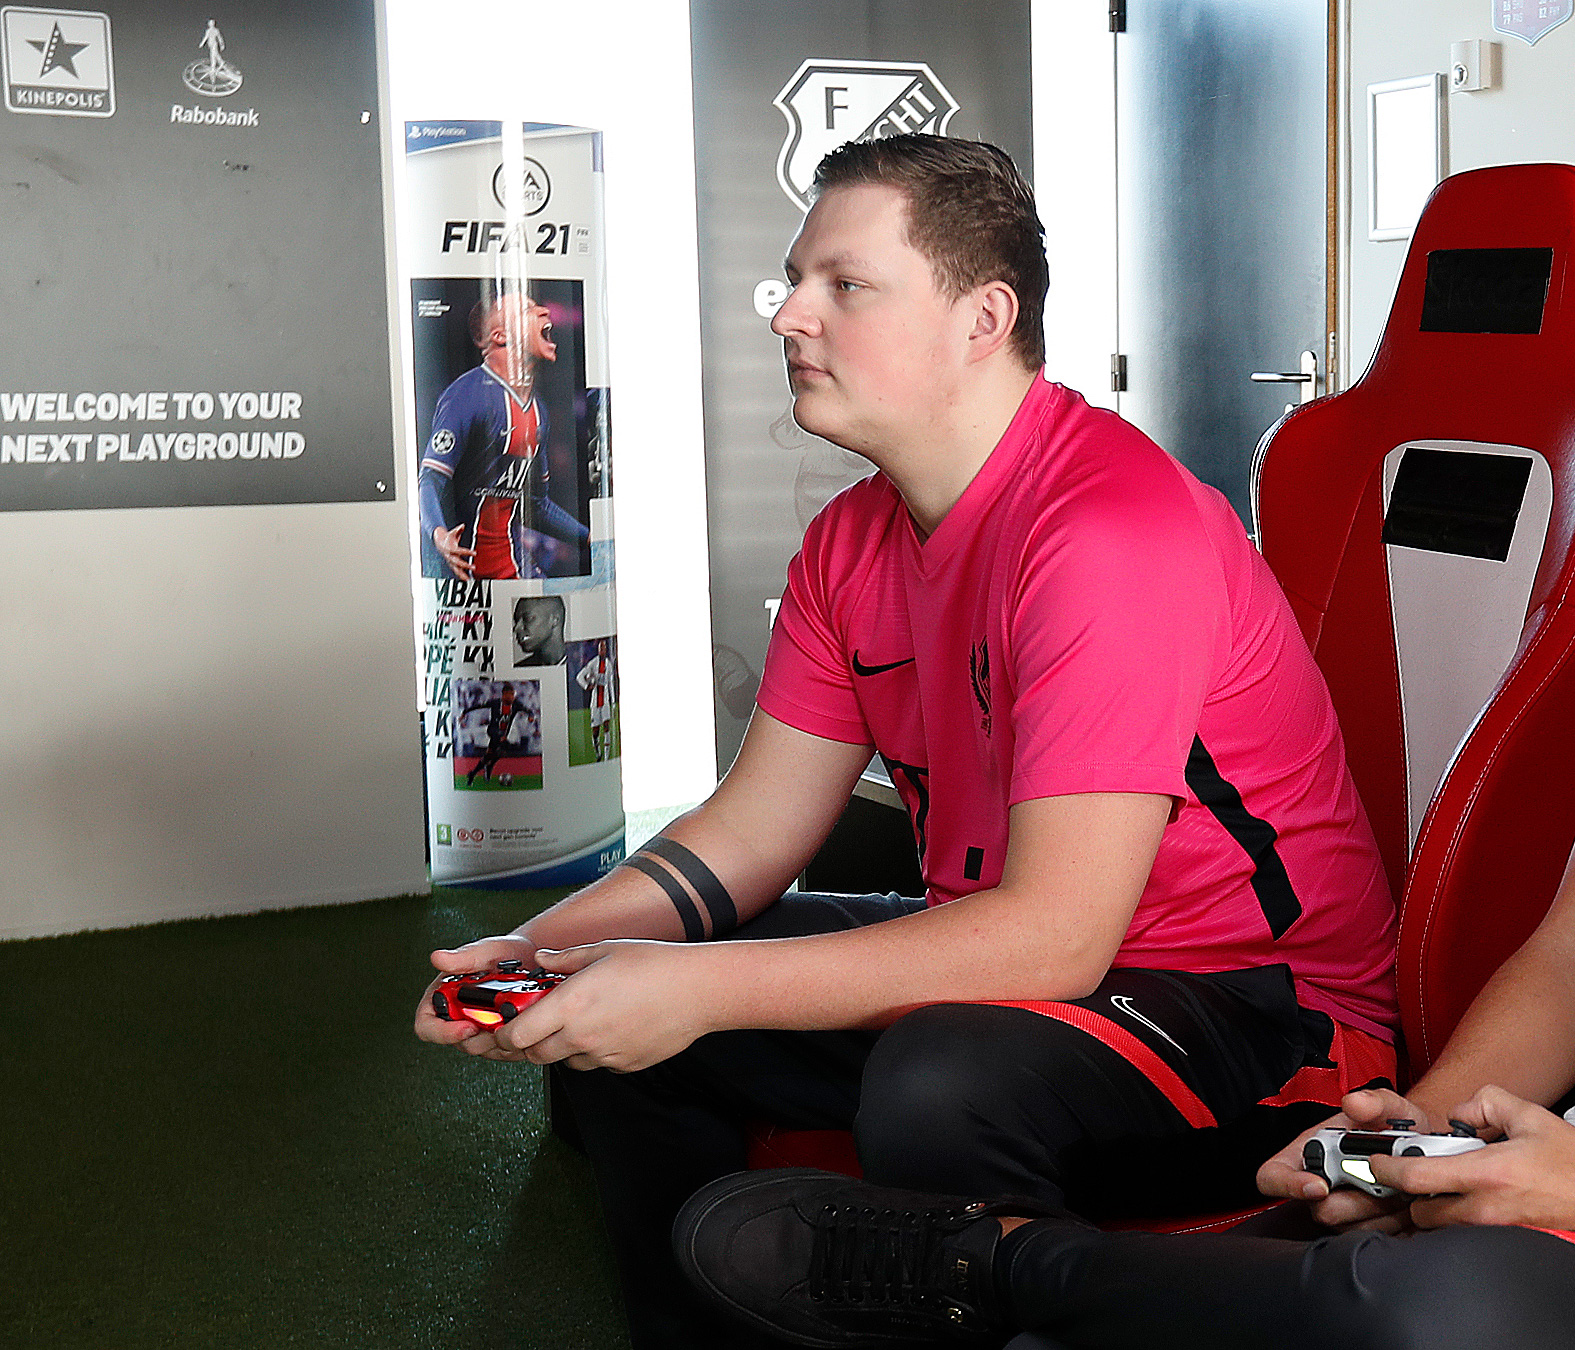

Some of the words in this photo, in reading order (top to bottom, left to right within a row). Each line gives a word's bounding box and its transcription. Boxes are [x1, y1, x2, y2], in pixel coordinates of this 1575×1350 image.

[16, 89, 104, 109] KINEPOLIS
[825, 87, 848, 130] F
[170, 105, 260, 127] Rabobank
[442, 221, 530, 253] FIFA
[536, 223, 571, 255] 21
[0, 392, 168, 421] WELCOME
[173, 392, 214, 420] TO
[219, 392, 302, 420] YOUR
[0, 433, 92, 463] NEXT
[96, 432, 305, 462] PLAYGROUND
